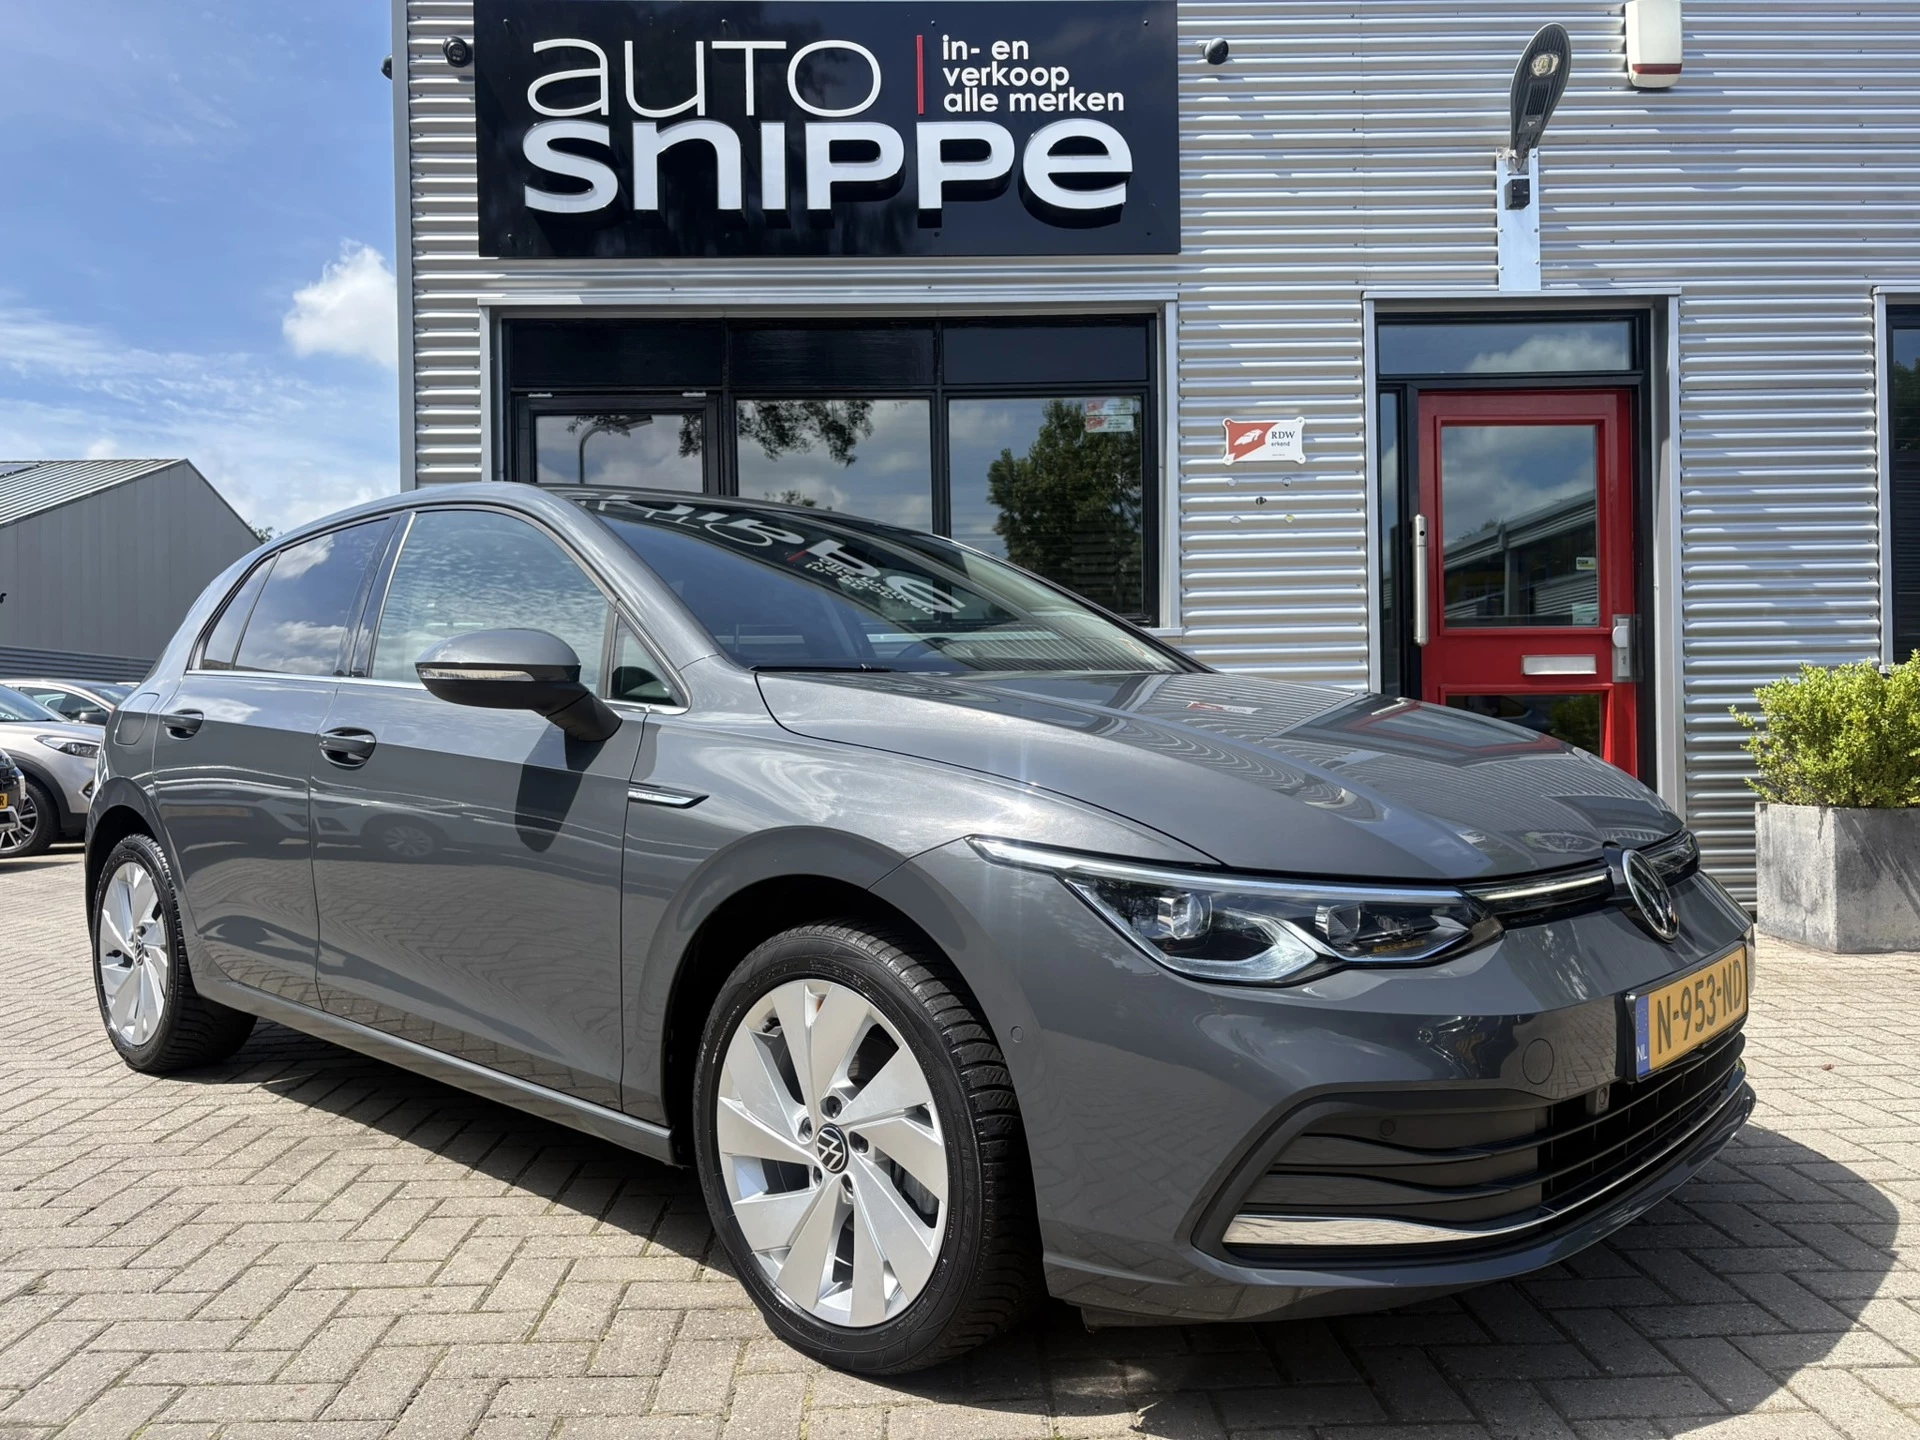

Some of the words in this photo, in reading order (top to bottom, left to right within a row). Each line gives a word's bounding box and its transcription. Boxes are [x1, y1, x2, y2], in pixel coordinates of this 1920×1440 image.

[942, 34, 981, 60] in-
[991, 40, 1029, 60] en
[942, 61, 1070, 92] verkoop
[943, 87, 999, 112] alle
[1009, 87, 1124, 112] merken
[1271, 430, 1295, 440] RDW
[1656, 958, 1743, 1055] N-953-ND
[1636, 1044, 1648, 1063] NL
